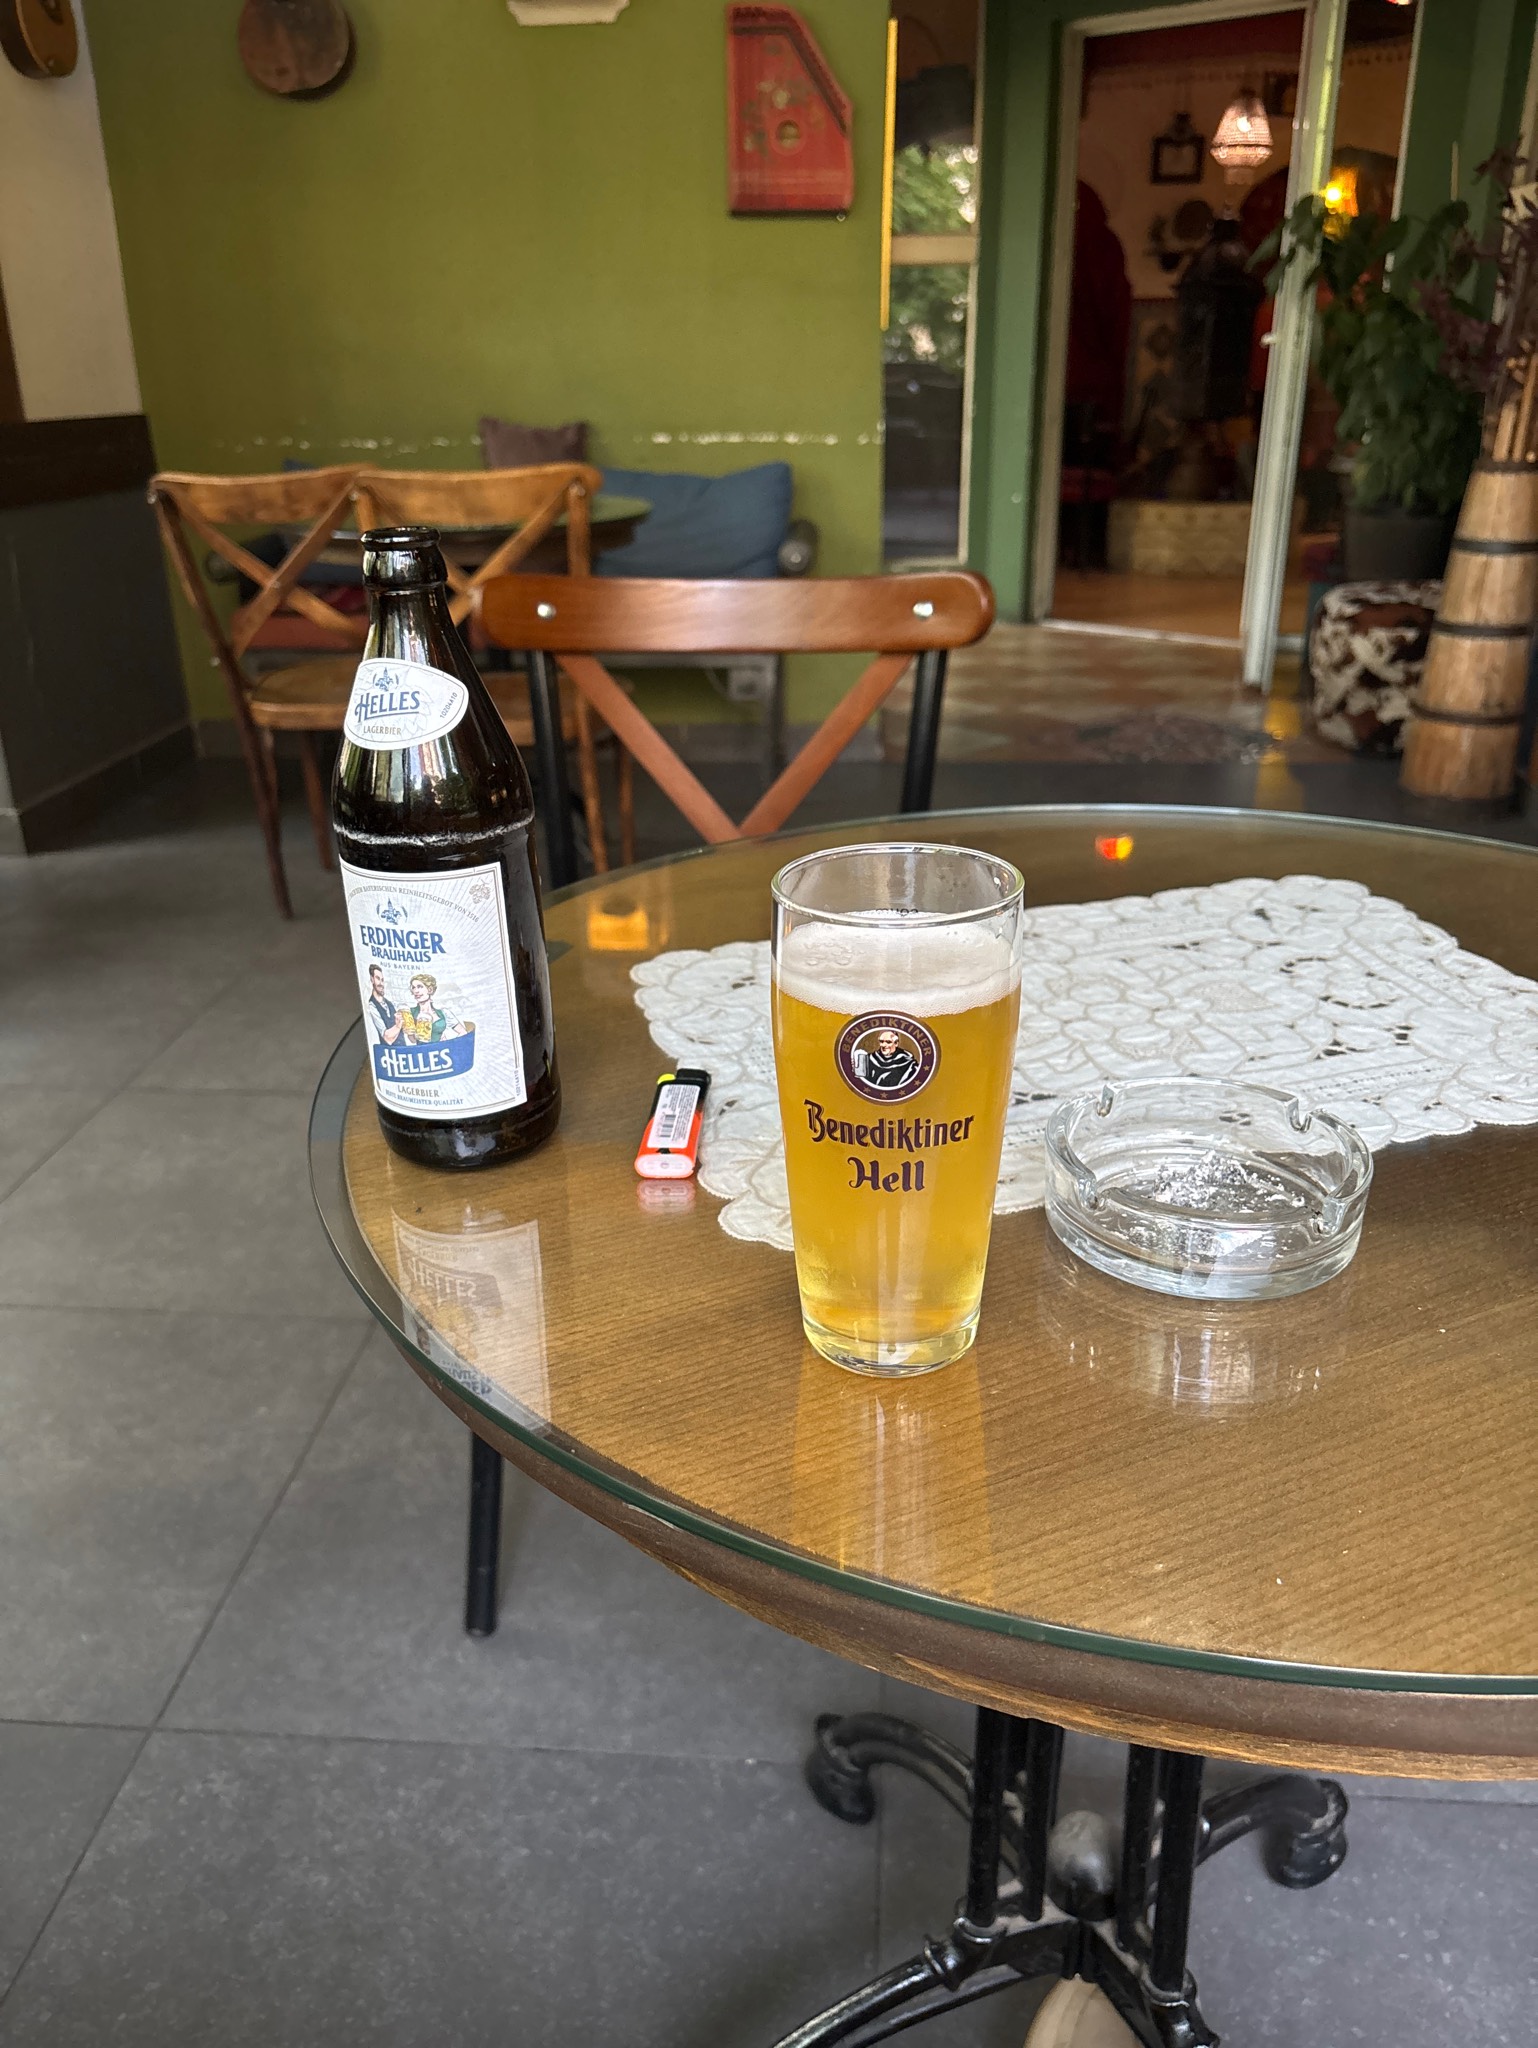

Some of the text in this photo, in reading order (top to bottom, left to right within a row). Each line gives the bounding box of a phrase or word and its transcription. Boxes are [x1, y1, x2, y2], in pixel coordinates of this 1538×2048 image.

[354, 691, 421, 723] HELLES
[363, 725, 402, 736] LAGERBIER
[398, 887, 454, 908] REINHEITSGEBOT
[454, 903, 467, 914] VON
[360, 924, 446, 954] ERDINGER
[371, 944, 432, 963] BRAUHAUS
[393, 963, 421, 971] BAYERN
[841, 1017, 933, 1057] BENEDIKTINER
[381, 1048, 454, 1078] HELLES
[397, 1084, 440, 1098] LAGERBIER
[803, 1099, 975, 1153] Benediktiner
[847, 1156, 926, 1193] Hell
